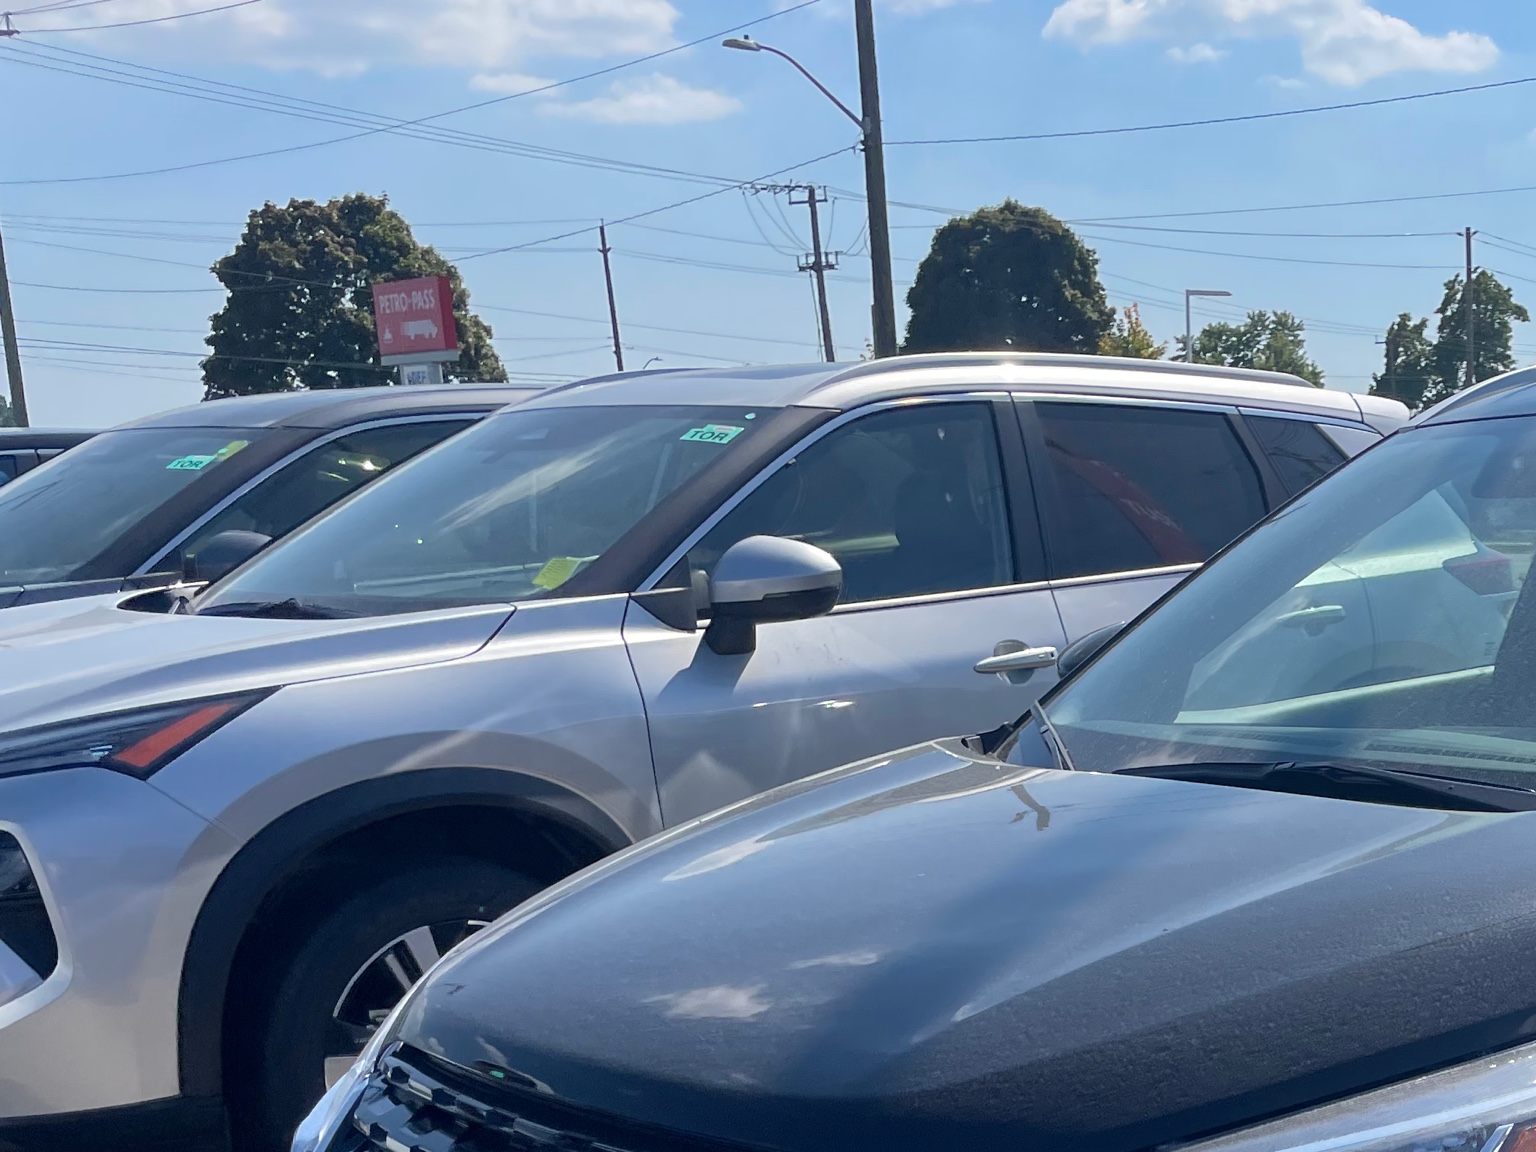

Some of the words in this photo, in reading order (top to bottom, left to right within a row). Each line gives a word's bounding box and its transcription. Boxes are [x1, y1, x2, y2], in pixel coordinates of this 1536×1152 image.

[378, 289, 436, 314] PETRO-PASS
[689, 430, 729, 442] TOR
[172, 460, 204, 468] TOR
